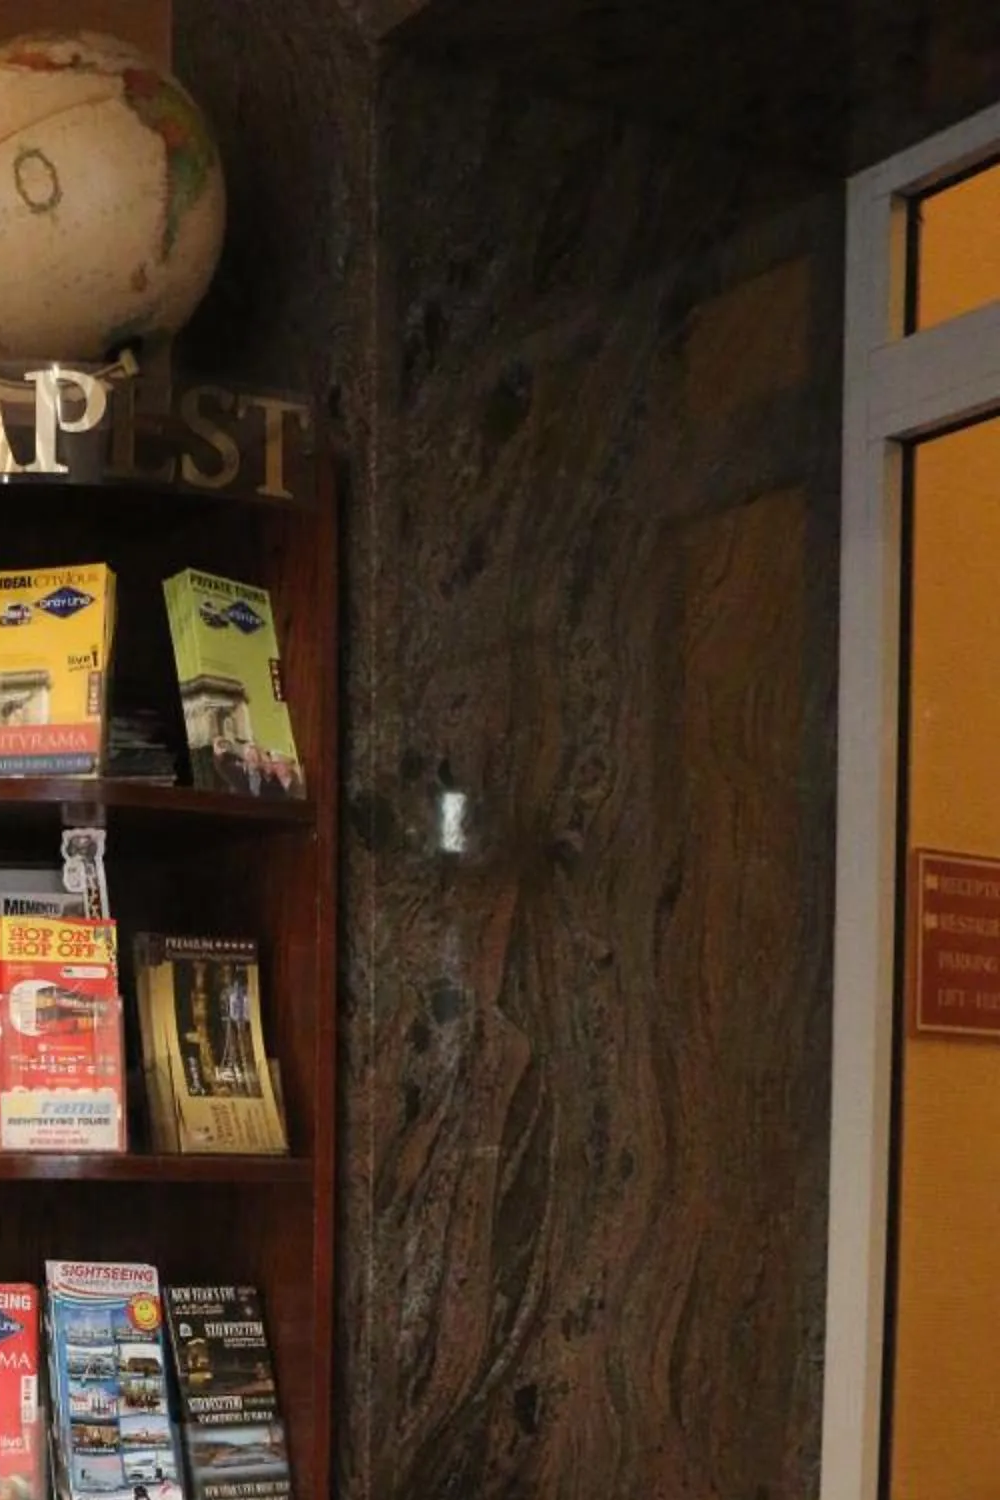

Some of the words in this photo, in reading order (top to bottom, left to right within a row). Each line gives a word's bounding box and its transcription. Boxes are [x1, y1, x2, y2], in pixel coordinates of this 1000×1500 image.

[8, 927, 53, 941] HOP
[58, 928, 92, 942] ON
[8, 942, 53, 957] HOP
[56, 943, 99, 957] OFF
[60, 1263, 154, 1283] SIGHTSEEING
